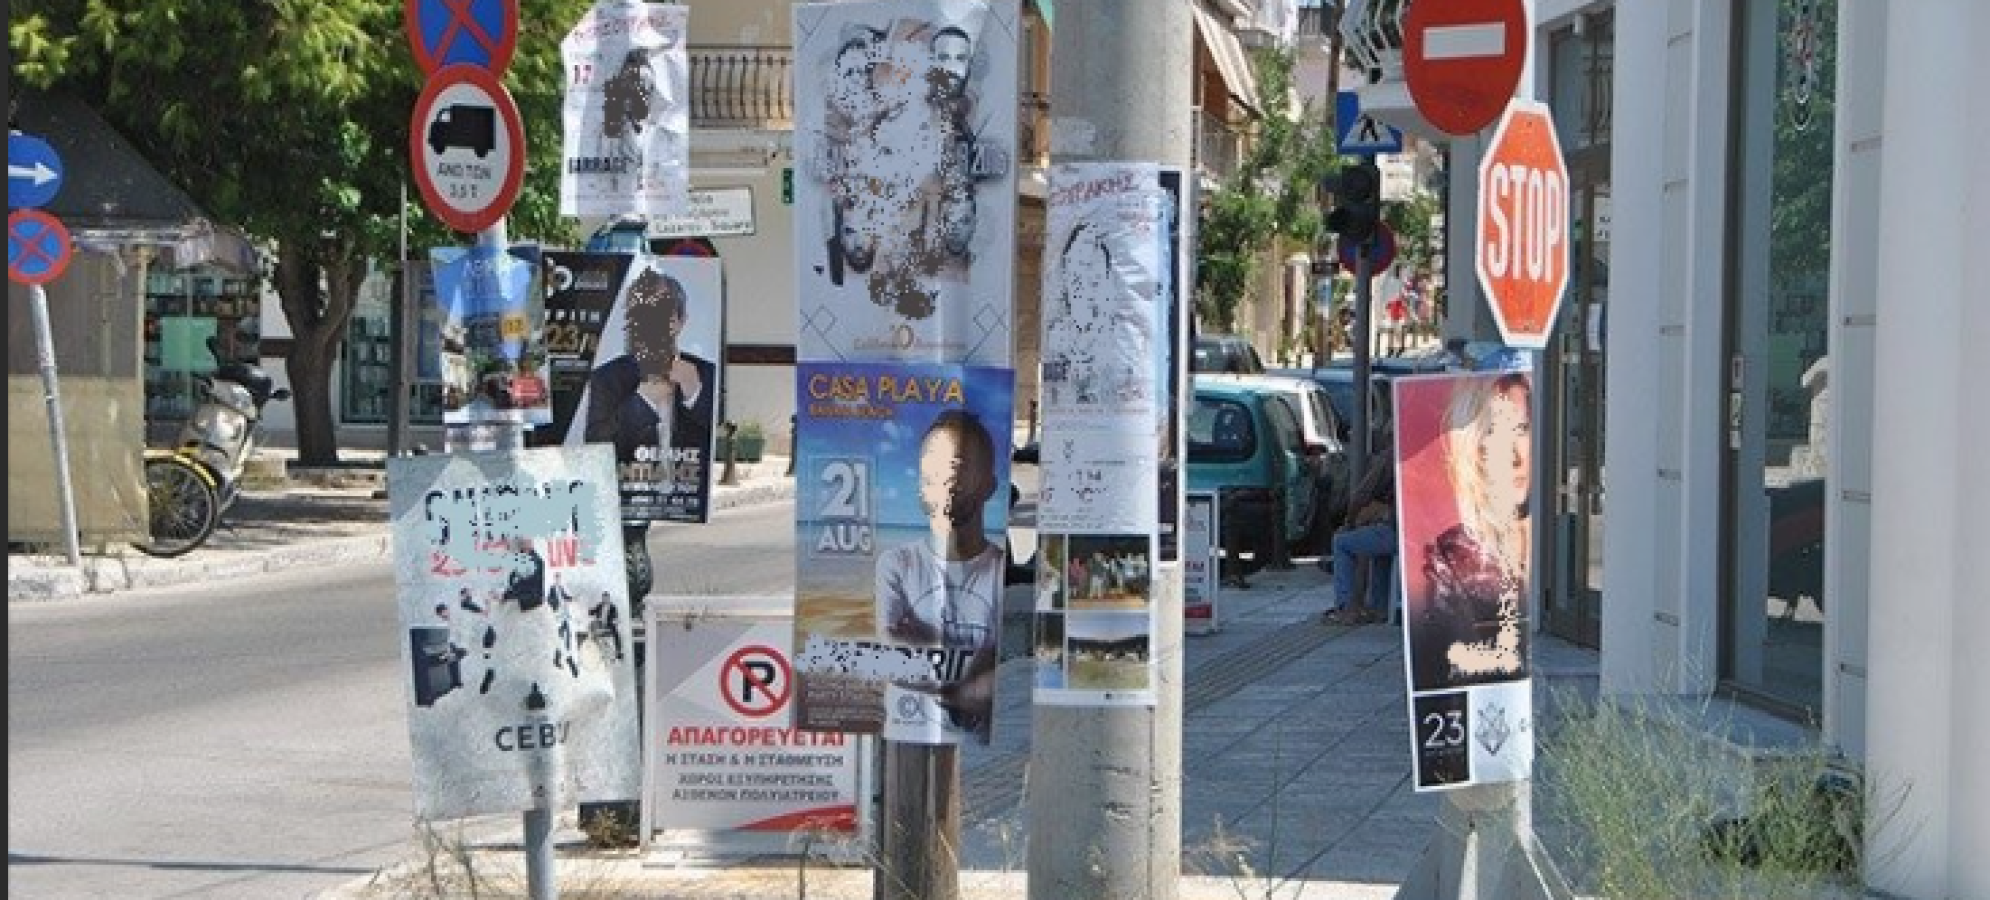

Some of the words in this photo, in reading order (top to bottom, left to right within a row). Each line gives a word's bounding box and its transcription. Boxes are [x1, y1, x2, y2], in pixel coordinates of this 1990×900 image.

[1486, 162, 1561, 282] STOP
[809, 373, 869, 400] CASA
[877, 376, 966, 406] PLAYA
[820, 462, 867, 521] 21
[816, 523, 873, 555] AUG
[667, 725, 845, 747] ΑΠΑΓΟΡΕΥΕΤΑΙ
[1423, 710, 1466, 748] 23
[680, 754, 726, 766] ΣΤΑΣΗ
[758, 754, 845, 767] ΣΤΑΘΜΕΥΣΗ
